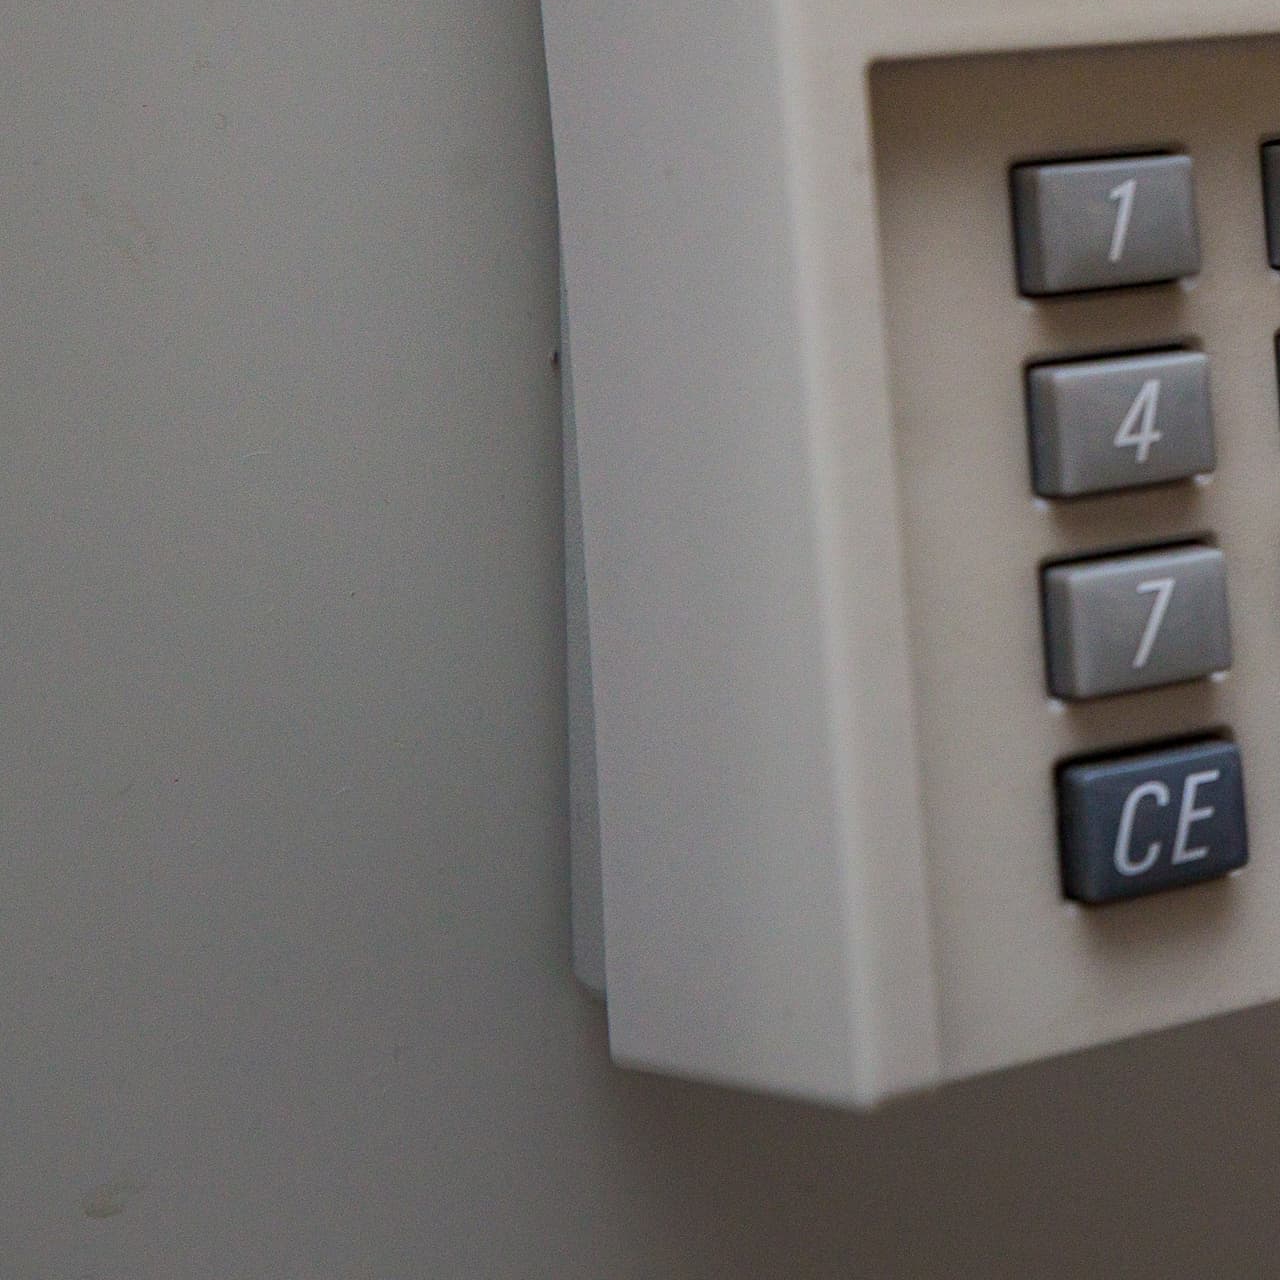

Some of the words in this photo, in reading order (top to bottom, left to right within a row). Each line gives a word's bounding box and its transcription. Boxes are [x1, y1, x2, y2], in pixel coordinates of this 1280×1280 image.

[1106, 178, 1137, 263] 1
[1113, 379, 1162, 464] 4
[1131, 577, 1174, 669] 7
[1113, 769, 1221, 878] CE
